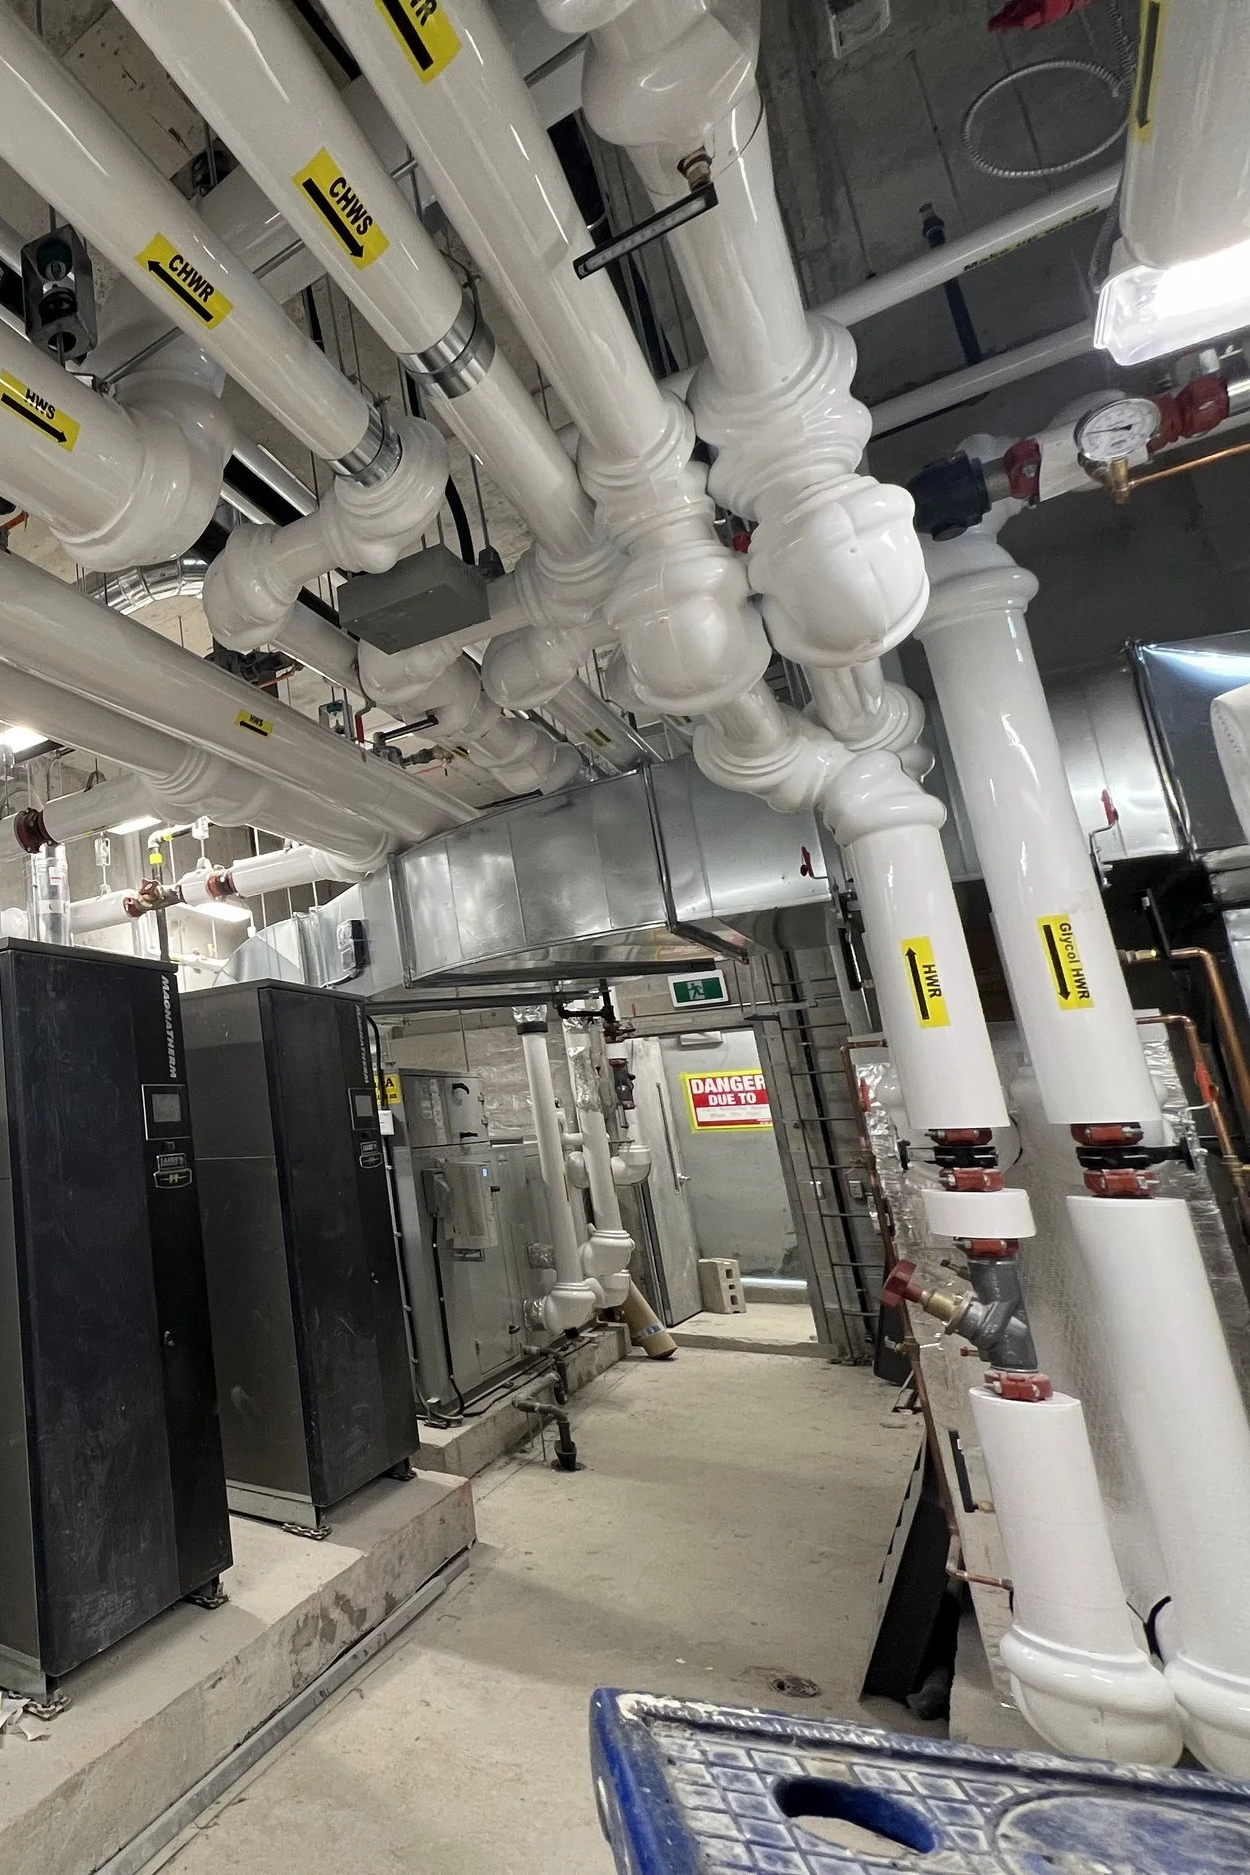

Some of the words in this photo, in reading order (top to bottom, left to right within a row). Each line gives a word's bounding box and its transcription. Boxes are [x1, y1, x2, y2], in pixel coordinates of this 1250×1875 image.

[329, 177, 373, 235] CHWS
[169, 255, 214, 303] CHWR
[25, 388, 55, 419] HWS
[922, 964, 942, 998] HWR
[1059, 922, 1081, 964] Glycol
[1071, 967, 1090, 999] HWR
[161, 975, 177, 1079] MAGNATHERM
[691, 1074, 766, 1094] DANGER
[708, 1093, 736, 1106] DUE
[738, 1092, 756, 1105] TO
